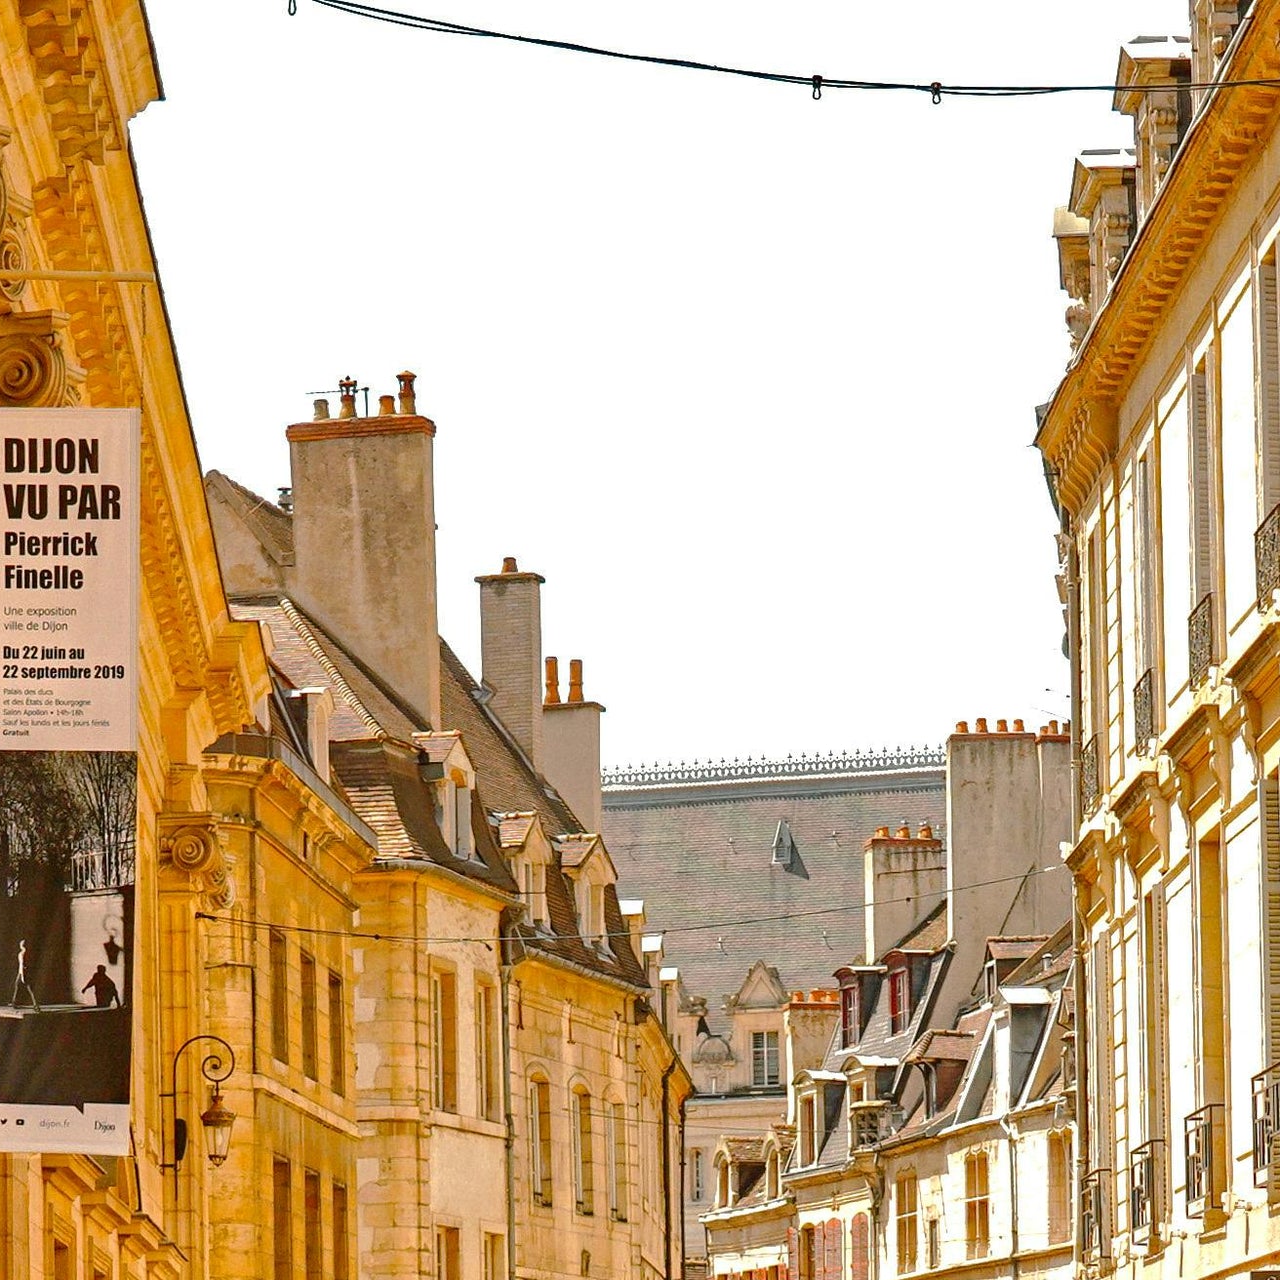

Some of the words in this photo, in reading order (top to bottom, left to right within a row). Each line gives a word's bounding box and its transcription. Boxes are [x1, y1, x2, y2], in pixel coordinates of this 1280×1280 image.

[4, 437, 99, 474] DIJON
[3, 484, 48, 520] VU
[58, 484, 121, 520] PAR
[4, 531, 98, 556] Pierrick
[4, 565, 83, 589] Finelle
[3, 606, 23, 616] Une
[26, 606, 77, 618] exposition
[3, 621, 24, 631] ville
[26, 621, 39, 631] de
[42, 621, 68, 633] Dijon
[3, 646, 20, 660] Du
[22, 646, 38, 660] 22
[41, 646, 66, 661] juin
[69, 648, 85, 660] au
[3, 665, 18, 679] 22
[21, 665, 91, 680] septembre
[94, 665, 125, 679] 2019
[55, 699, 91, 708] Bourgogne
[2, 728, 29, 737] Gratuit
[39, 1119, 70, 1129] dijon.fr
[94, 1120, 116, 1133] Dijon
